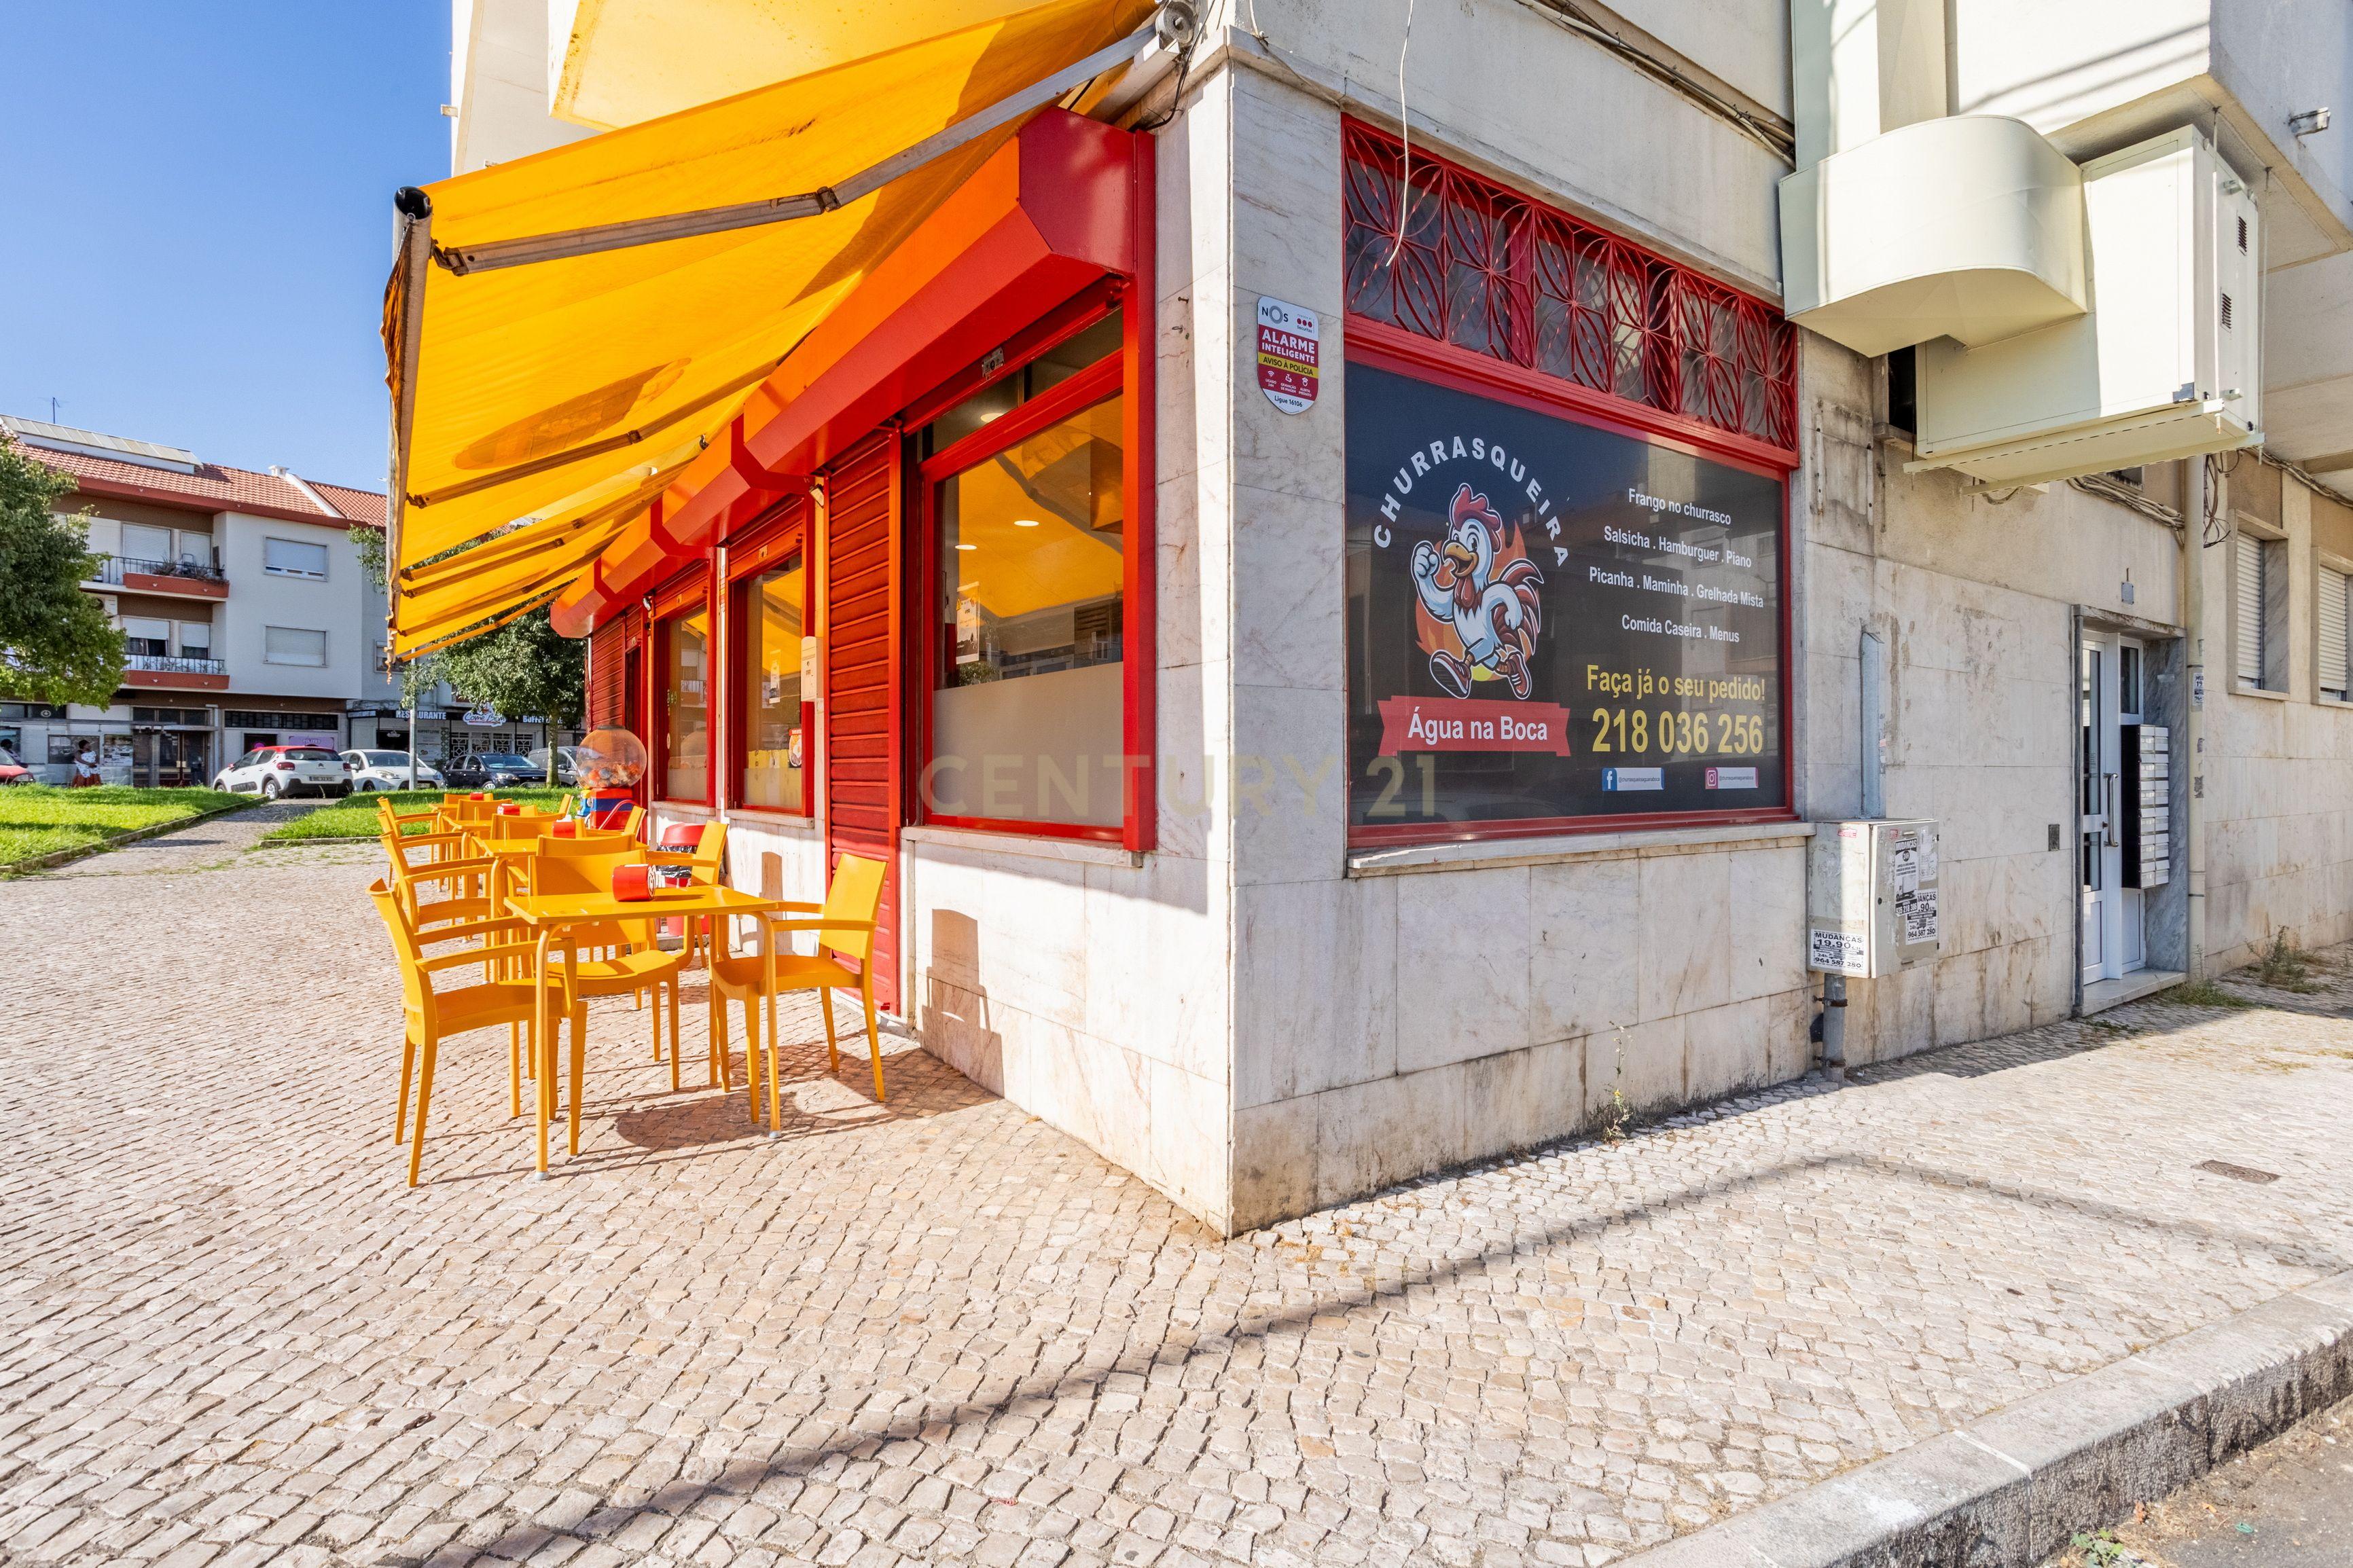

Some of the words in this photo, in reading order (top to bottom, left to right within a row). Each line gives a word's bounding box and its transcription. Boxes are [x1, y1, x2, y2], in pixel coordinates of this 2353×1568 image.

[1261, 306, 1289, 324] NOS
[1261, 342, 1315, 364] INTELIGENTE
[1262, 329, 1315, 354] ALARME
[1263, 356, 1282, 367] AVISO
[1283, 359, 1289, 369] À
[1289, 363, 1314, 376] POLÍCIA
[1274, 395, 1288, 404] Ligue
[1289, 399, 1303, 407] 16106
[1373, 435, 1569, 567] CHURRASQUEIRA
[1628, 488, 1666, 513] Frango
[1668, 500, 1681, 513] no
[1683, 502, 1731, 526] churrasco
[1604, 526, 1650, 549] Salsicha
[1659, 536, 1719, 562] Hamburguer
[1726, 550, 1752, 568] Piano
[1589, 566, 1634, 588] Picanha
[1643, 575, 1689, 597] Maminha
[1696, 583, 1738, 604] Grelhada
[1740, 591, 1764, 608] Mista
[1621, 614, 1662, 634] Comida
[1664, 619, 1702, 638] Caseira
[1709, 625, 1740, 642] Menus
[1587, 664, 1632, 698] Faça
[1636, 668, 1653, 700] já
[1658, 676, 1670, 695] o
[1674, 676, 1704, 697] seu
[1709, 676, 1765, 704] pedido!
[1407, 706, 1464, 746] Água
[1470, 720, 1494, 740] na
[1500, 716, 1547, 741] Boca
[1592, 708, 1649, 753] 218
[1658, 710, 1709, 754] 036
[1717, 713, 1763, 754] 256
[1816, 939, 1851, 949] 19.90
[1918, 929, 1926, 937] 587
